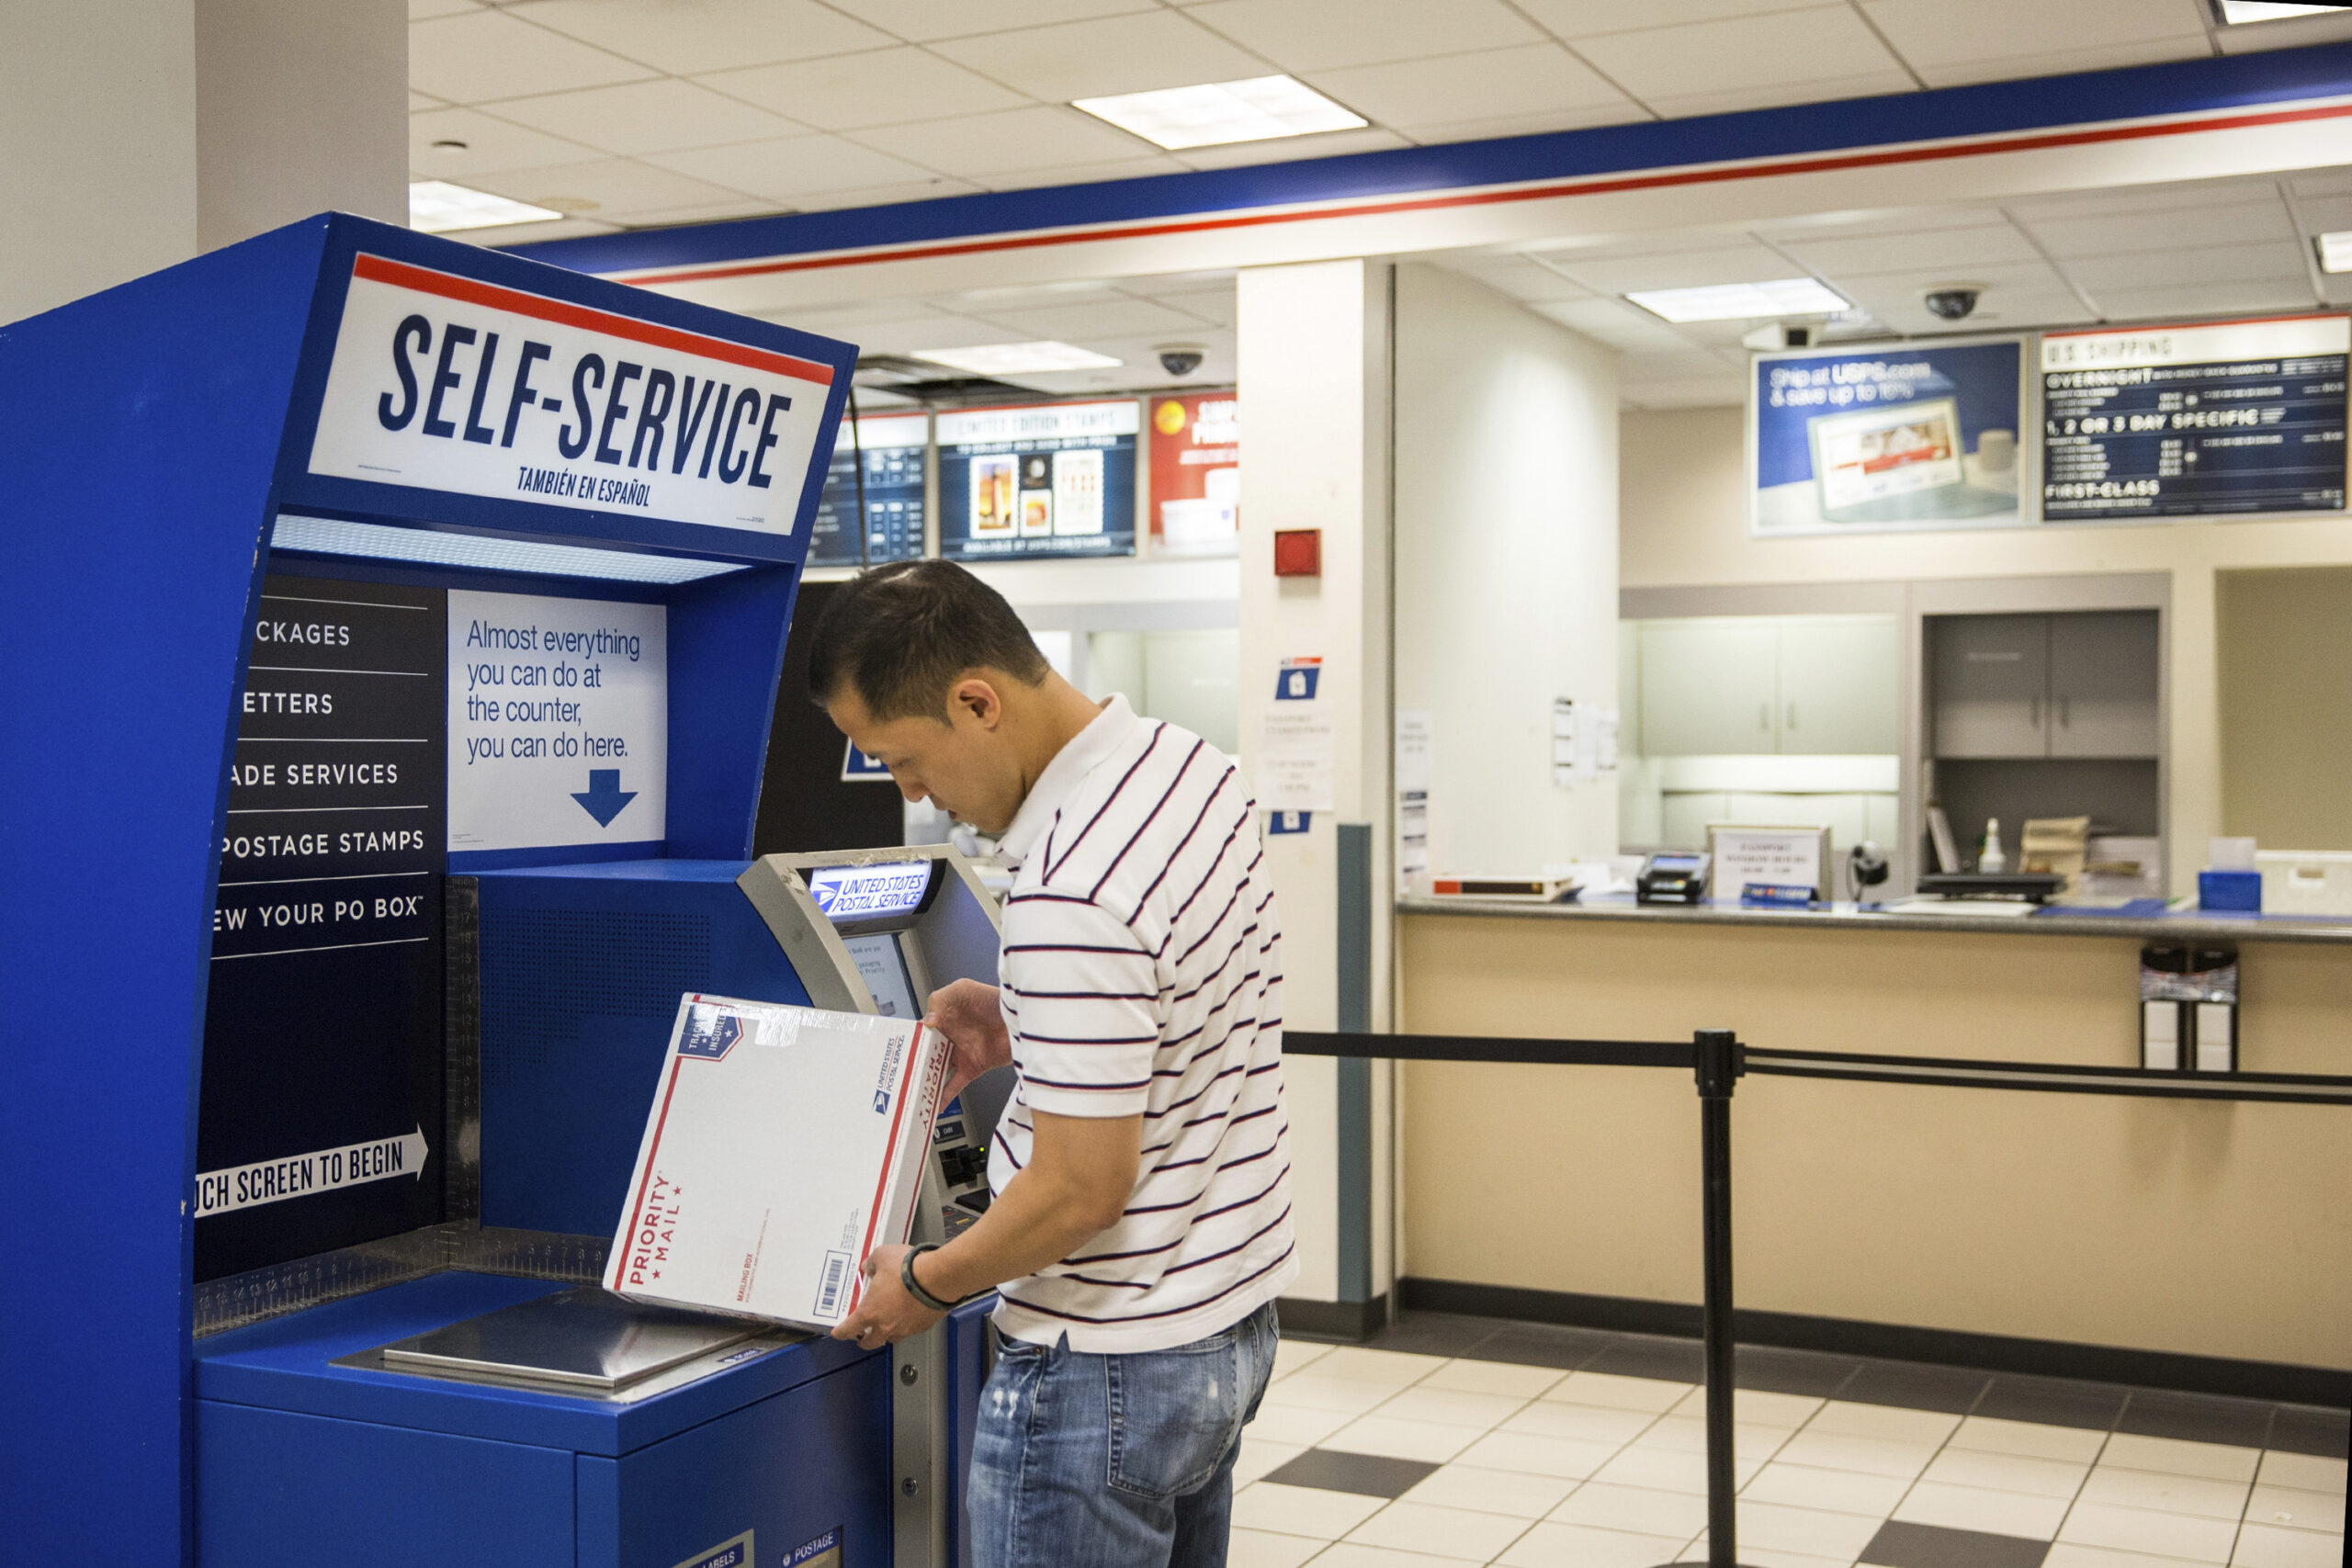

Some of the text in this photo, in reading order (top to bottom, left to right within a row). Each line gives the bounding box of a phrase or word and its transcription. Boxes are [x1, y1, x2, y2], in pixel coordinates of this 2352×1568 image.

[1811, 367, 1830, 386] at
[1832, 361, 1930, 384] USPS.com
[2046, 368, 2153, 389] OVERNIGHT
[379, 314, 792, 489] SELF-SERVICE
[1770, 387, 1785, 407] &
[1786, 388, 1827, 406] save
[1828, 386, 1854, 406] up
[1856, 382, 1876, 402] to
[2064, 419, 2077, 434] 2
[2081, 417, 2109, 434] OR
[2130, 413, 2167, 432] DAY
[2171, 408, 2259, 430] SPECIFIC
[517, 467, 650, 507] TAMBIÉN EN ESPAÑOL
[2045, 479, 2159, 500] FIRST-CLASS
[256, 621, 349, 645] CKAGES
[467, 619, 640, 661] Almost everything
[467, 659, 601, 692] you can do at
[243, 692, 333, 714] ETTERS
[468, 694, 582, 726] the counter,
[467, 731, 628, 764] you can do here.
[287, 764, 398, 785] SERVICES
[339, 830, 424, 852] STAMPS
[842, 874, 924, 896] UNITED STATES
[259, 903, 324, 928] YOUR
[335, 900, 364, 921] PO
[832, 891, 921, 912] POSTAL SERVICE
[877, 1037, 895, 1089] UNITED STATES
[887, 1066, 898, 1092] POSTAL
[922, 1057, 935, 1102] MAIL
[923, 1041, 945, 1130] PRIORITY
[237, 1158, 312, 1203] SCREEN
[320, 1152, 342, 1186] TO
[350, 1141, 402, 1180] BEGIN
[630, 1175, 669, 1285] PRIORITY
[655, 1205, 680, 1261] MAIL
[737, 1253, 752, 1302] MAILING BOX
[795, 1531, 833, 1561] POSTAGE
